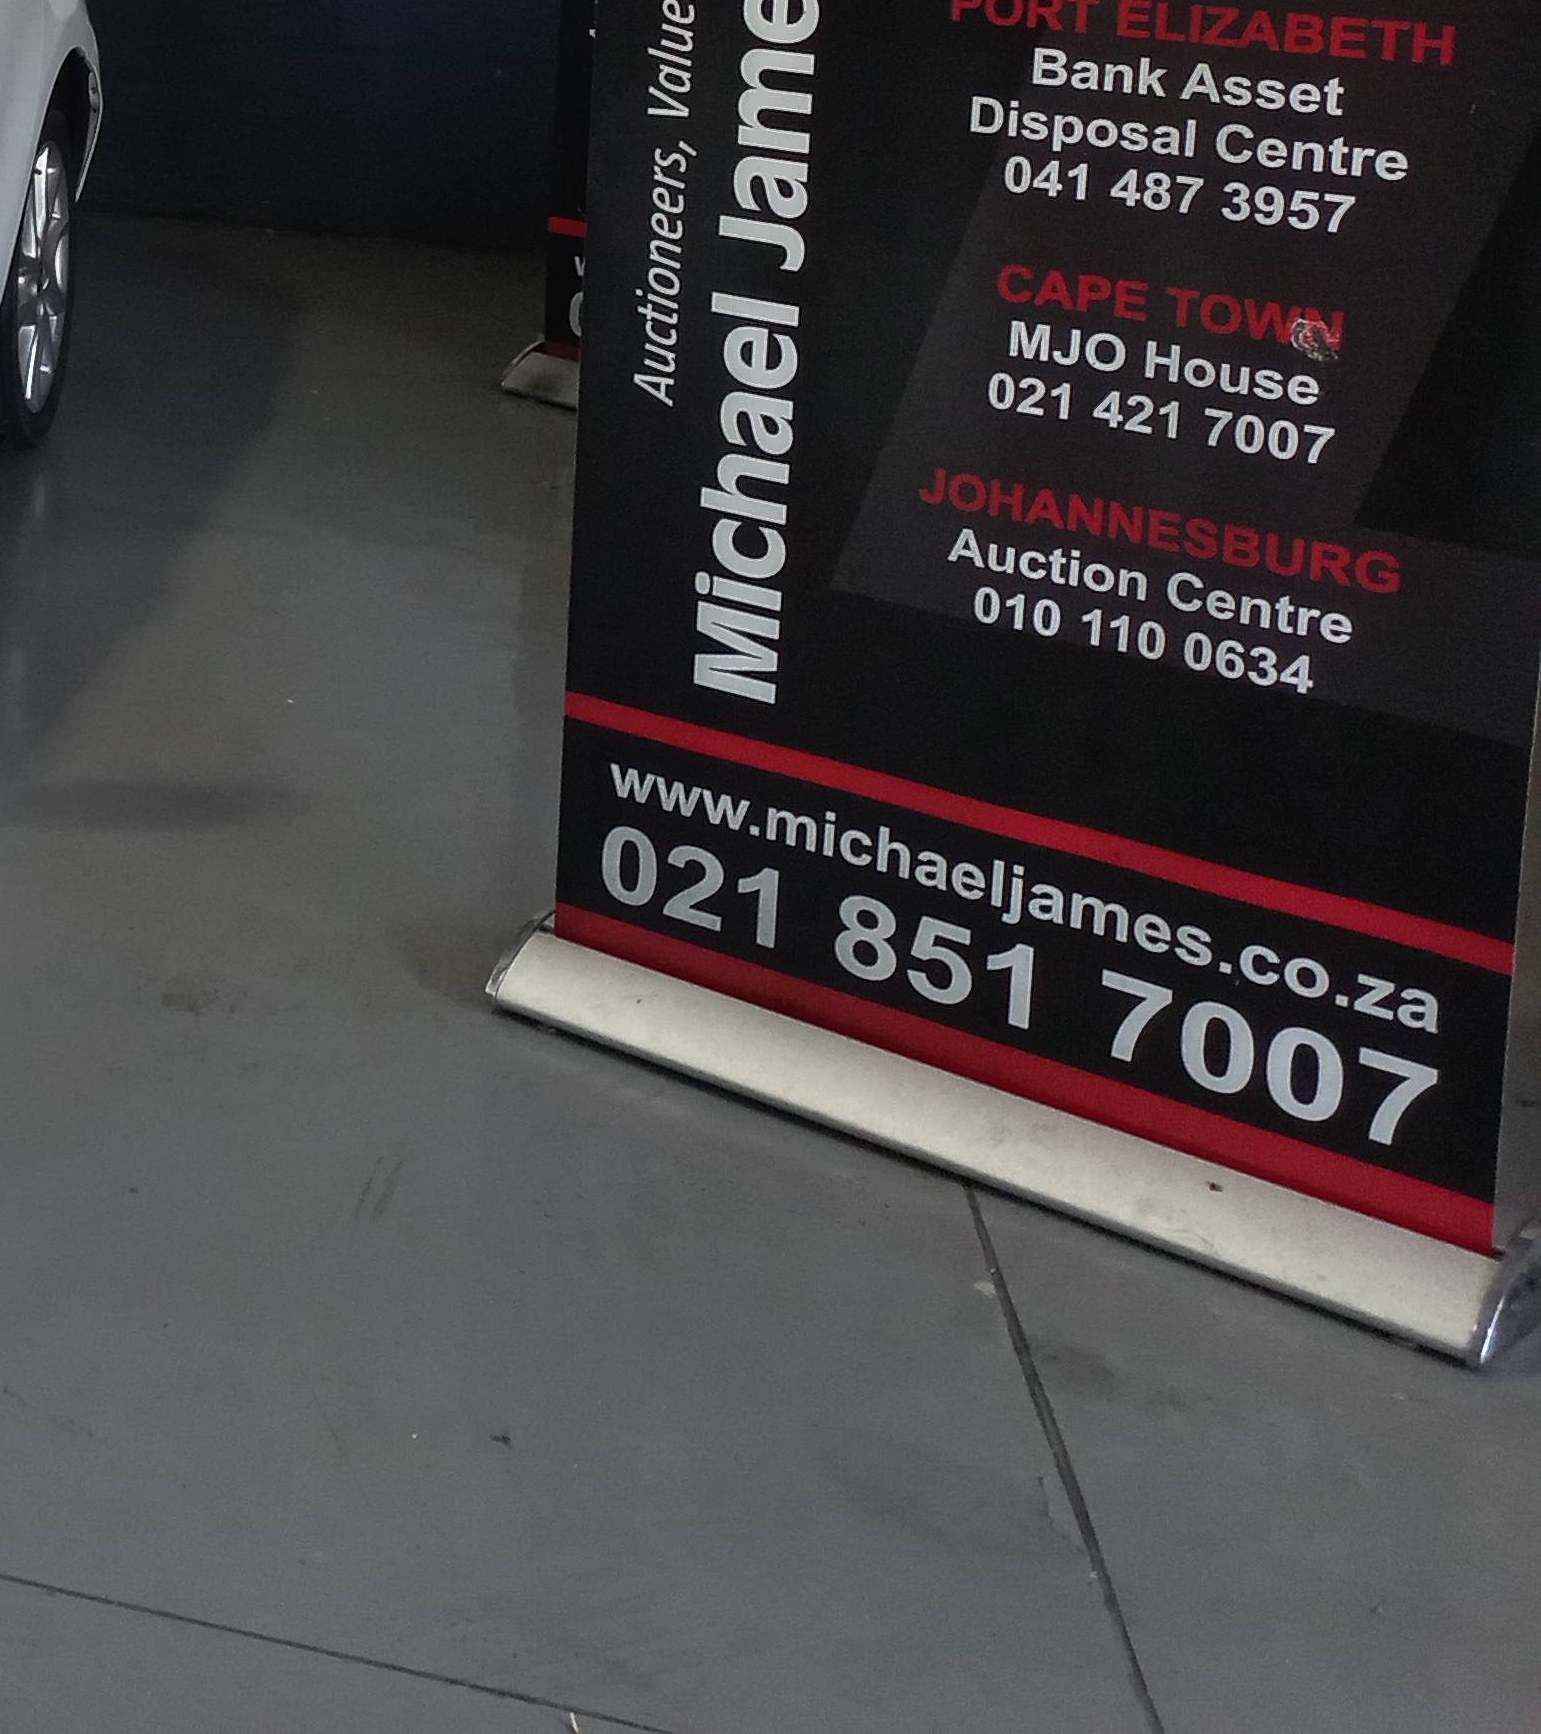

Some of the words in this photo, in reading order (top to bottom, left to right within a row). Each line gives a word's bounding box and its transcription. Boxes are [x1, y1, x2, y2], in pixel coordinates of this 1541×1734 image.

[1033, 48, 1167, 97] Bank
[1180, 63, 1344, 115] Asset
[970, 96, 1196, 157] Disposal
[1216, 124, 1408, 180] Centre
[1005, 156, 1087, 200] 041
[1110, 169, 1204, 213] 487
[1222, 183, 1356, 232] 3957
[634, 141, 696, 406] Auctioneers,
[998, 264, 1148, 319] CAPE
[1169, 287, 1343, 349] TOWN
[1010, 321, 1125, 371] MJO
[1144, 339, 1320, 405] House
[989, 373, 1070, 419] 021
[1093, 391, 1179, 438] 421
[1205, 408, 1335, 463] 7007
[694, 292, 799, 704] Michael
[921, 469, 1399, 592] JOHANNESBURG
[948, 529, 1147, 601] Auction
[1168, 573, 1352, 643] Centre
[975, 587, 1060, 636] 010
[1082, 609, 1165, 659] 110
[1185, 633, 1313, 694] 0634
[608, 762, 1439, 1035] www.michaeljames.co.za
[602, 825, 779, 948] 021
[835, 895, 1034, 1029] 851
[1098, 969, 1440, 1146] 7007
